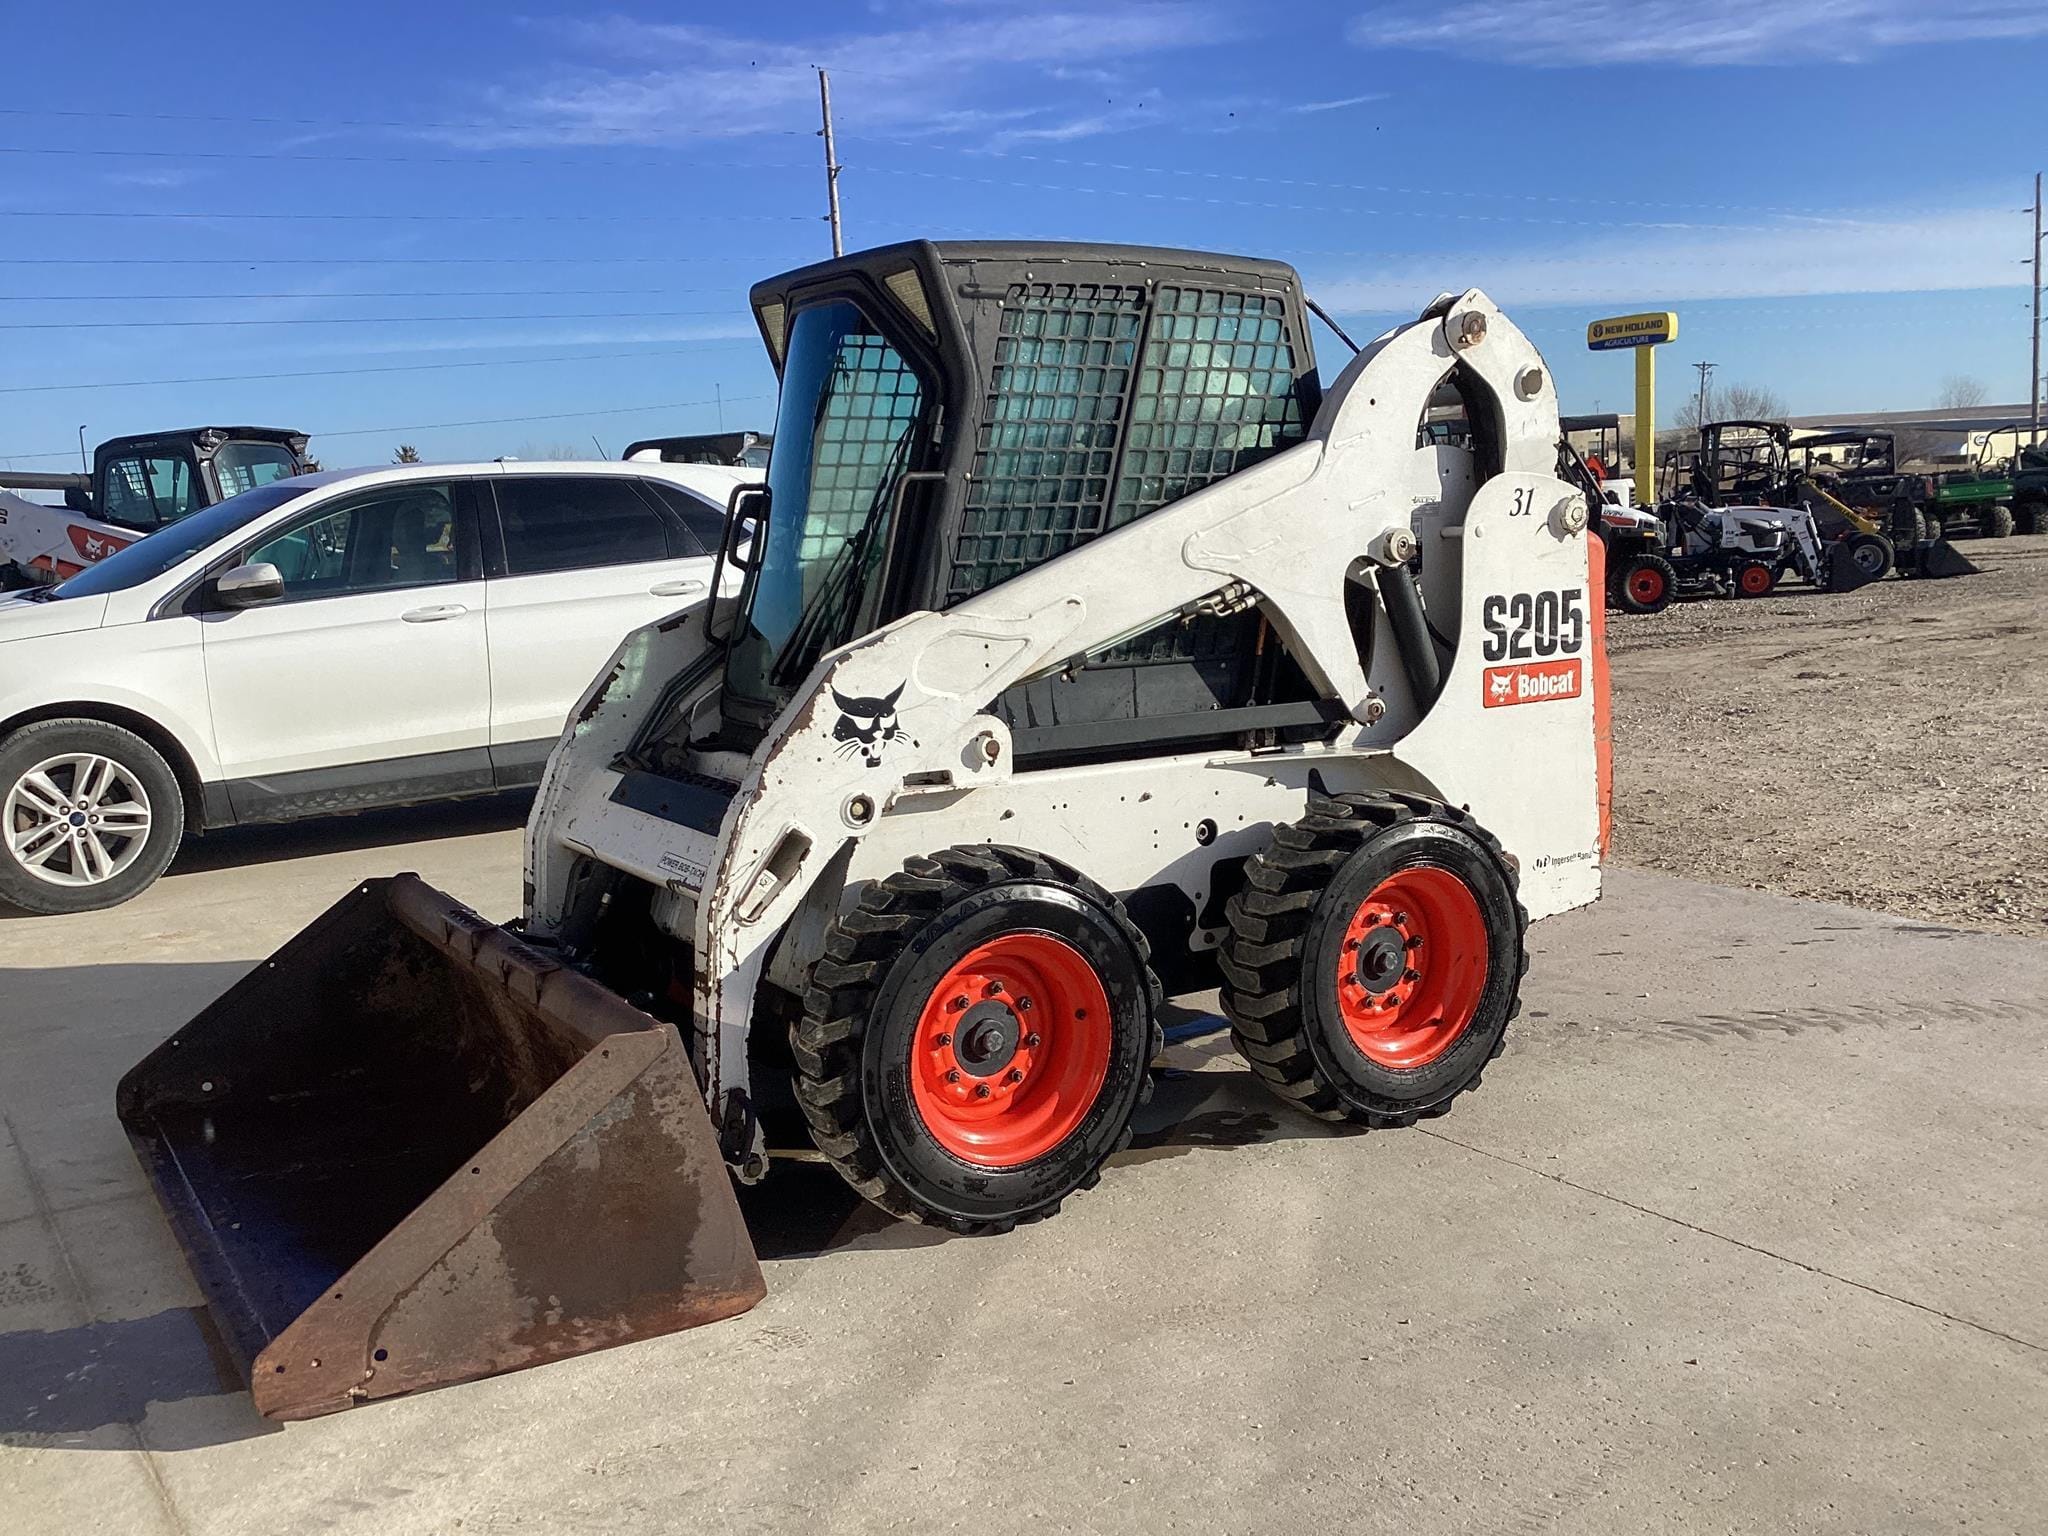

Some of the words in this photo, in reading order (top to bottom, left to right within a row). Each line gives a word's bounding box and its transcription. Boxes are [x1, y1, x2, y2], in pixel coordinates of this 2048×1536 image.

[1604, 335, 1649, 347] AGRICULTURE
[1605, 326, 1624, 335] NEW
[1624, 319, 1663, 332] HOLLAND
[1509, 487, 1535, 517] 31
[1483, 588, 1583, 662] S205
[1518, 669, 1575, 698] Bobcat
